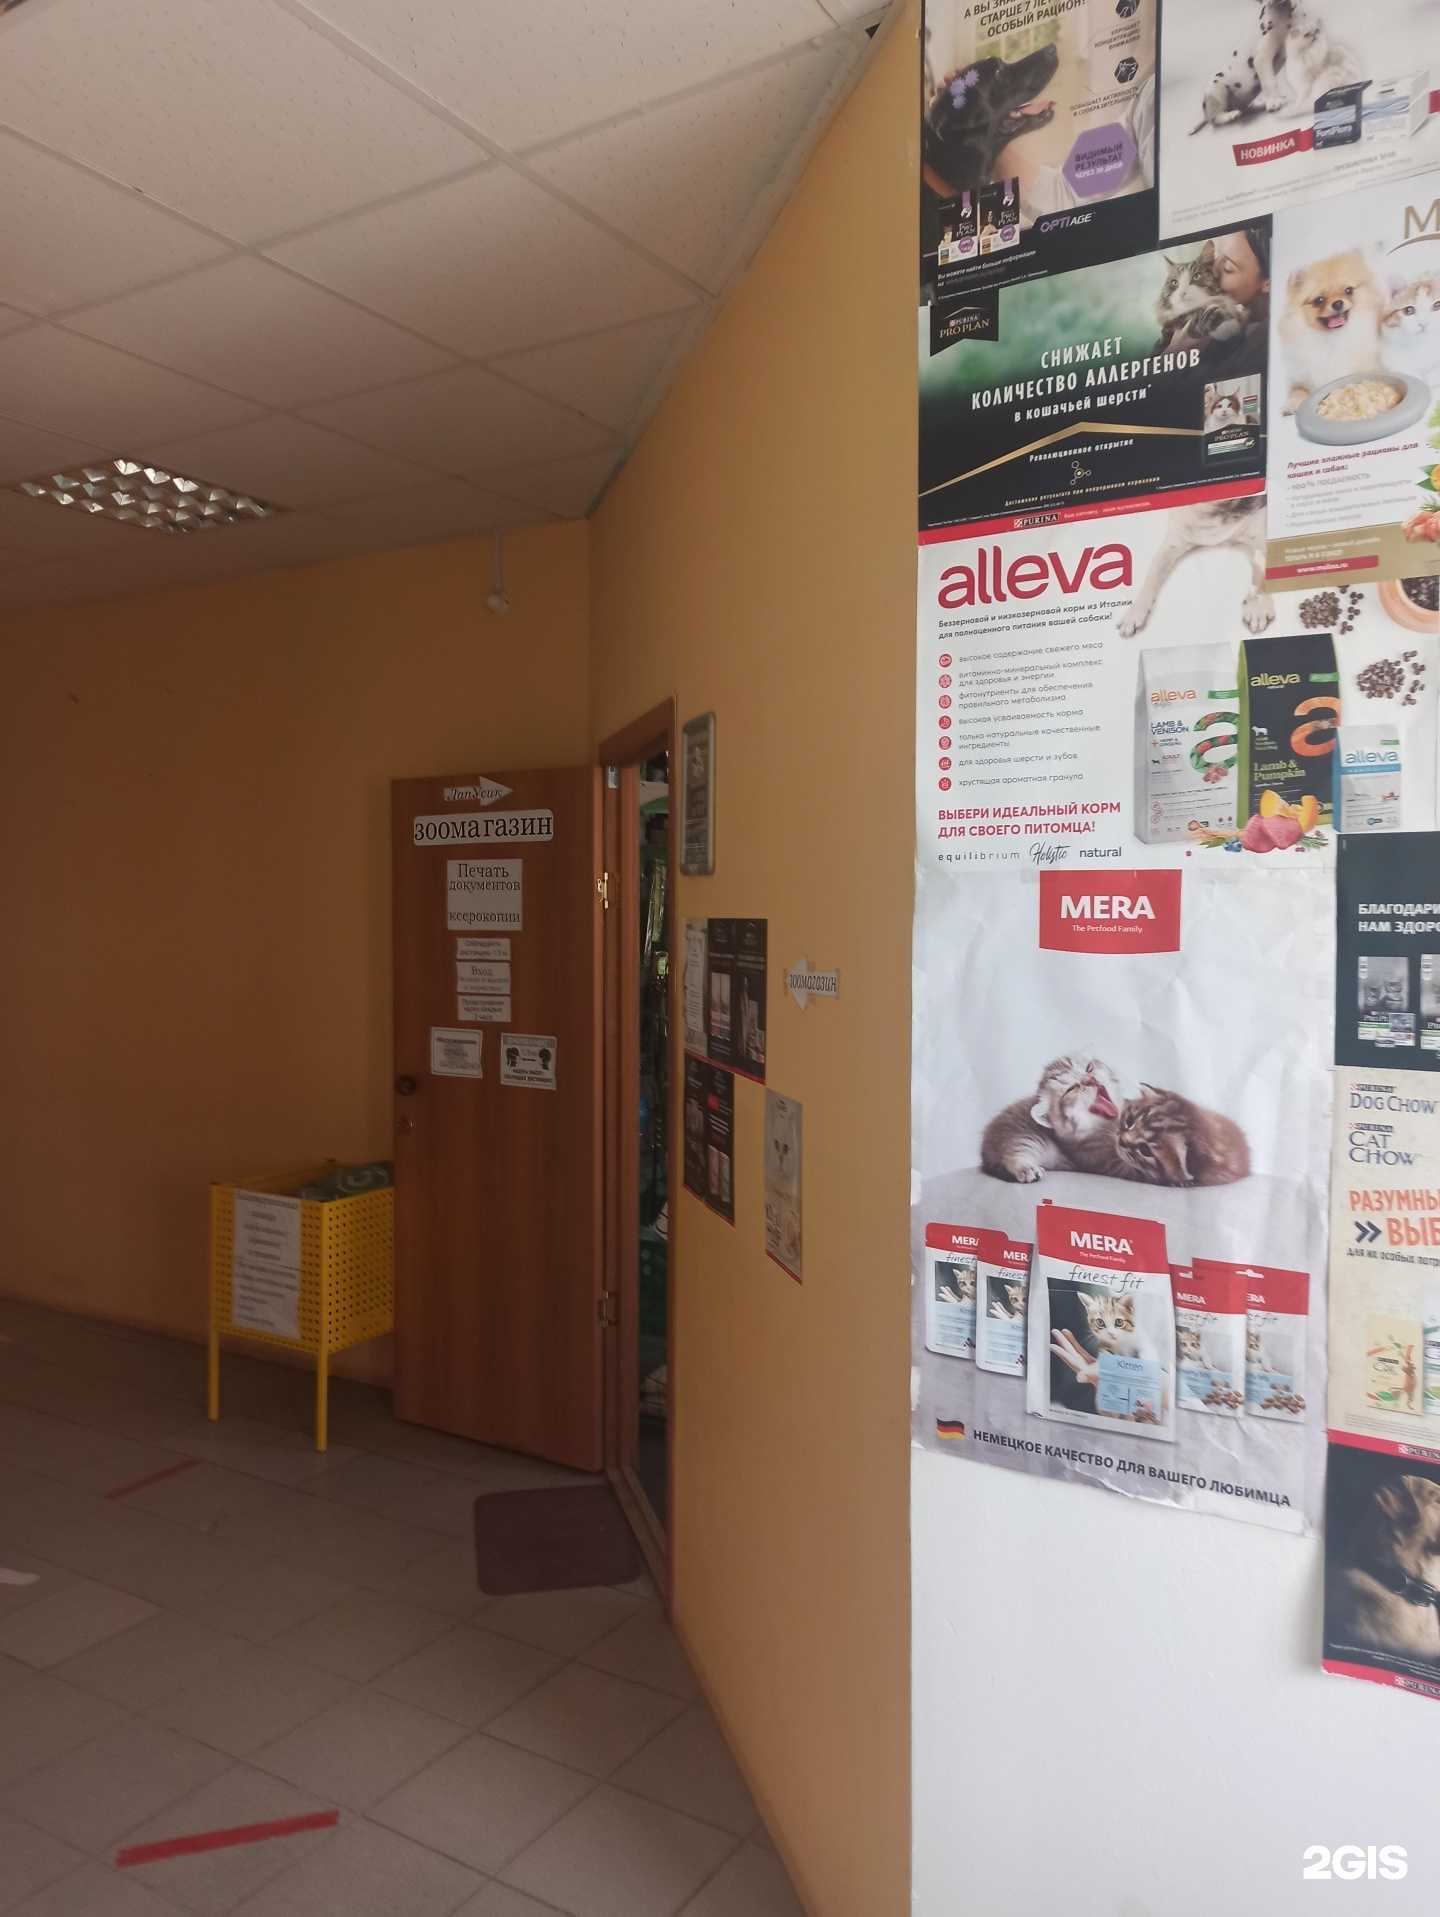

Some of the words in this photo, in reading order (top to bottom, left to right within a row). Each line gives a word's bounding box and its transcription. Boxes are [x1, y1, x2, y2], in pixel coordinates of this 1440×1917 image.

[974, 1, 990, 15] ВЫ
[980, 3, 1022, 26] СТАРШЕ
[987, 12, 1034, 37] ОСОБЫЙ
[1240, 138, 1296, 160] НОВИНКА
[963, 319, 990, 333] PLAN
[1041, 336, 1123, 369] СНИЖАЕТ
[971, 372, 1077, 410] КОЛИЧЕСТВО
[1086, 349, 1200, 386] АЛЛЕРГЕНОВ
[1014, 411, 1021, 423] в
[1026, 396, 1091, 420] кошачьей
[1094, 438, 1134, 451] открытие
[1023, 513, 1058, 526] PURINA
[937, 543, 1133, 609] alleva
[938, 615, 989, 628] Беззерновой
[997, 607, 1061, 621] низкозерновой
[1063, 604, 1085, 615] корм
[1087, 602, 1097, 610] из
[1099, 598, 1133, 610] Италии
[938, 631, 953, 640] для
[954, 624, 1011, 638] полноценного
[1012, 620, 1046, 631] питания
[1048, 615, 1076, 627] вашей
[1078, 612, 1113, 624] собаки!
[959, 680, 973, 688] для
[1250, 673, 1301, 687] alleva
[1021, 687, 1036, 695] для
[1151, 688, 1197, 702] alleva
[1151, 721, 1175, 729] LAMB
[1151, 726, 1189, 736] VENISON
[959, 759, 973, 767] для
[1345, 749, 1398, 764] alleva
[1254, 760, 1287, 771] Lamb
[1288, 759, 1297, 769] &
[1254, 767, 1306, 781] Pumpkin
[938, 808, 989, 820] ВЫБЕРИ
[992, 802, 1078, 820] ИДЕАЛЬНЫЙ
[1081, 802, 1121, 815] КОРМ
[414, 816, 553, 841] зоомагазин
[938, 825, 966, 839] ДЛЯ
[968, 824, 1021, 837] СВОЕГО
[1024, 821, 1096, 837] ПИТОМЦА!
[938, 851, 1020, 863] equilibrium
[1029, 841, 1071, 865] Holistic
[1079, 847, 1122, 858] natural
[458, 863, 509, 878] Печать
[449, 880, 521, 893] документов
[1060, 895, 1156, 919] MERA
[449, 911, 521, 925] ксерокопии
[1087, 924, 1116, 932] Petfood
[1118, 925, 1143, 934] Family
[1358, 921, 1392, 932] НАМ
[1349, 1131, 1392, 1149] CAT
[1349, 1147, 1413, 1165] CHOW
[1070, 1230, 1134, 1256] MERA
[1069, 1264, 1119, 1285] finest
[1115, 1272, 1144, 1293] fit
[1176, 1291, 1206, 1305] MERA
[974, 1429, 1042, 1455] НЕМЕЦКОЕ
[1045, 1444, 1113, 1470] КАЧЕСТВО
[1117, 1458, 1145, 1475] ДЛЯ
[1149, 1466, 1207, 1490] ВАШЕГО
[1210, 1480, 1291, 1507] ЛЮБИМЦА
